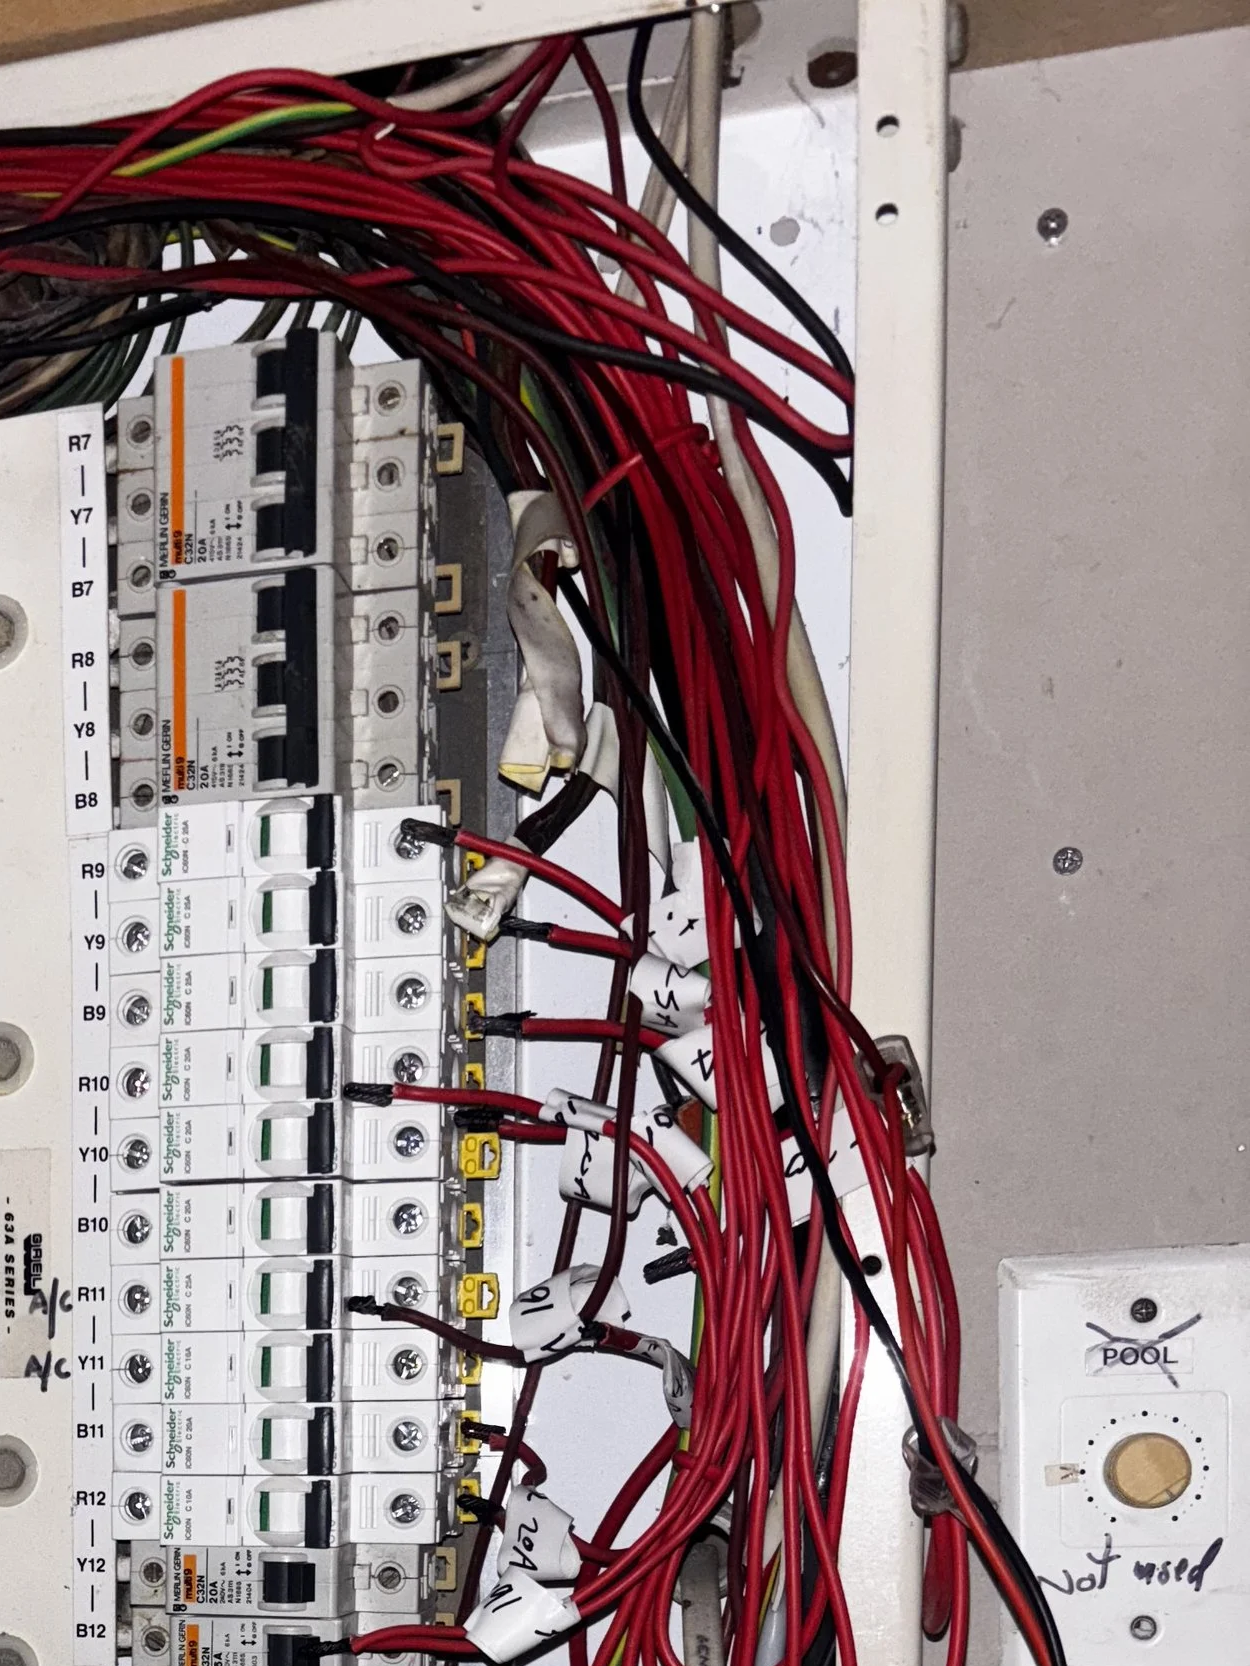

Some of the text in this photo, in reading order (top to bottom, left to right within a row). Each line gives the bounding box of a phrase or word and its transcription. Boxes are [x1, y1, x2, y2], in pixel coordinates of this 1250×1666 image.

[68, 433, 92, 453] R7
[70, 507, 93, 525] Y7
[198, 539, 207, 562] 20A
[71, 580, 94, 598] B7
[71, 651, 95, 669] R8
[73, 721, 96, 739] Y8
[200, 765, 209, 789] 20A
[75, 791, 98, 810] B8
[162, 812, 177, 876] Schneider
[81, 862, 105, 880] R9
[164, 888, 179, 951] Schneider
[84, 934, 106, 950] Y9
[164, 962, 179, 1026] Schneider
[83, 1004, 106, 1022] B9
[162, 1038, 177, 1101] Schneider
[78, 1075, 110, 1092] R10
[163, 1111, 178, 1174] Schneider
[78, 1146, 109, 1163] Y10
[77, 1216, 109, 1233] B10
[163, 1191, 178, 1253] Schneider
[4, 1212, 15, 1319] 63A SERIES
[77, 1286, 105, 1302] R11
[163, 1266, 178, 1328] Schneider
[77, 1355, 104, 1371] Y11
[1101, 1345, 1179, 1366] POOL
[165, 1338, 180, 1400] Schneider
[76, 1423, 104, 1439] B11
[166, 1408, 181, 1469] Schneider
[76, 1490, 106, 1506] R12
[164, 1480, 179, 1540] Schneider
[76, 1557, 106, 1573] Y12
[209, 1581, 218, 1603] 20A
[76, 1623, 106, 1639] B12
